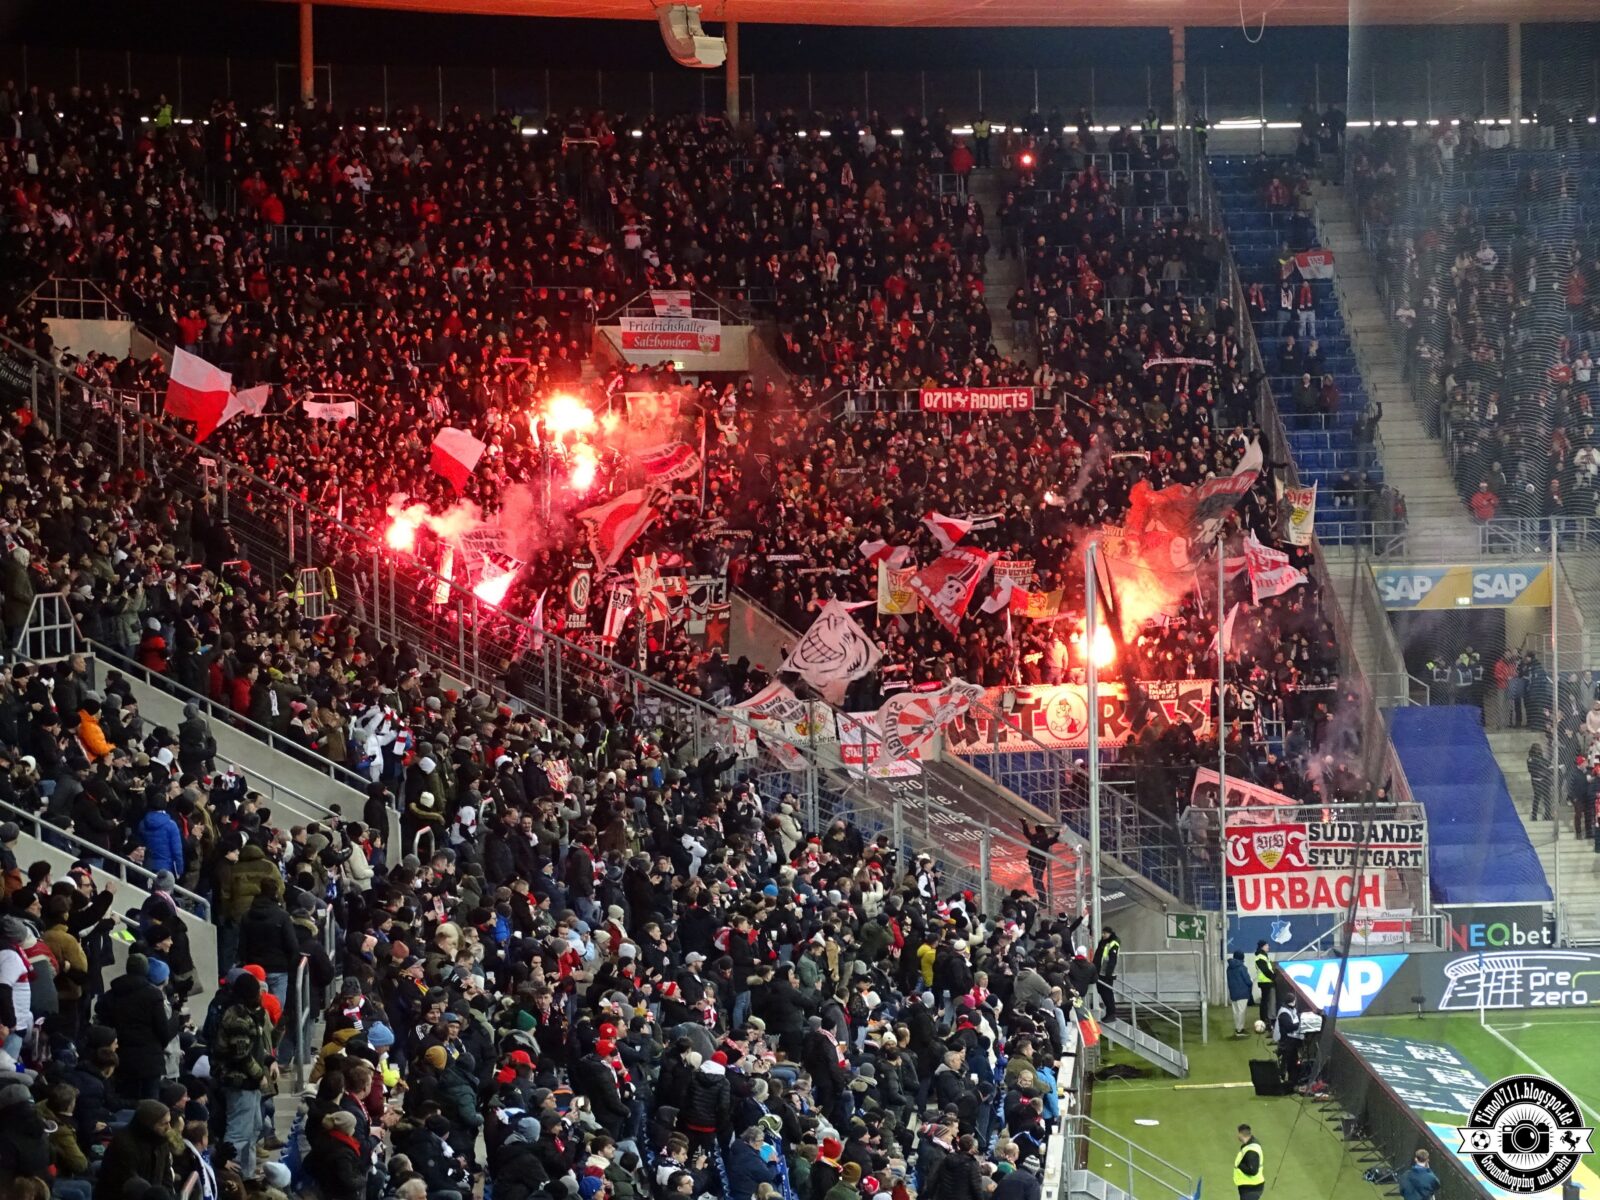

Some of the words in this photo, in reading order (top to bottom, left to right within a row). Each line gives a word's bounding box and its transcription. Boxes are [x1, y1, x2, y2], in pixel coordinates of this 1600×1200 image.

[628, 318, 706, 333] Friedrichshaller
[633, 334, 691, 347] Salzbomber
[923, 391, 953, 408] 0711
[970, 391, 1028, 409] ADDICTS
[1378, 576, 1432, 600] SAP
[1473, 573, 1528, 599] SAP
[1308, 822, 1424, 843] SÜDBANDE
[1256, 834, 1284, 850] VfB
[1308, 848, 1422, 867] STUTTGART
[1100, 890, 1126, 903] Arena
[1238, 874, 1381, 911] URBACH
[1447, 922, 1551, 952] NEO.bet
[1284, 959, 1384, 1017] SAP
[1530, 971, 1571, 989] pre
[1530, 990, 1587, 1006] zero
